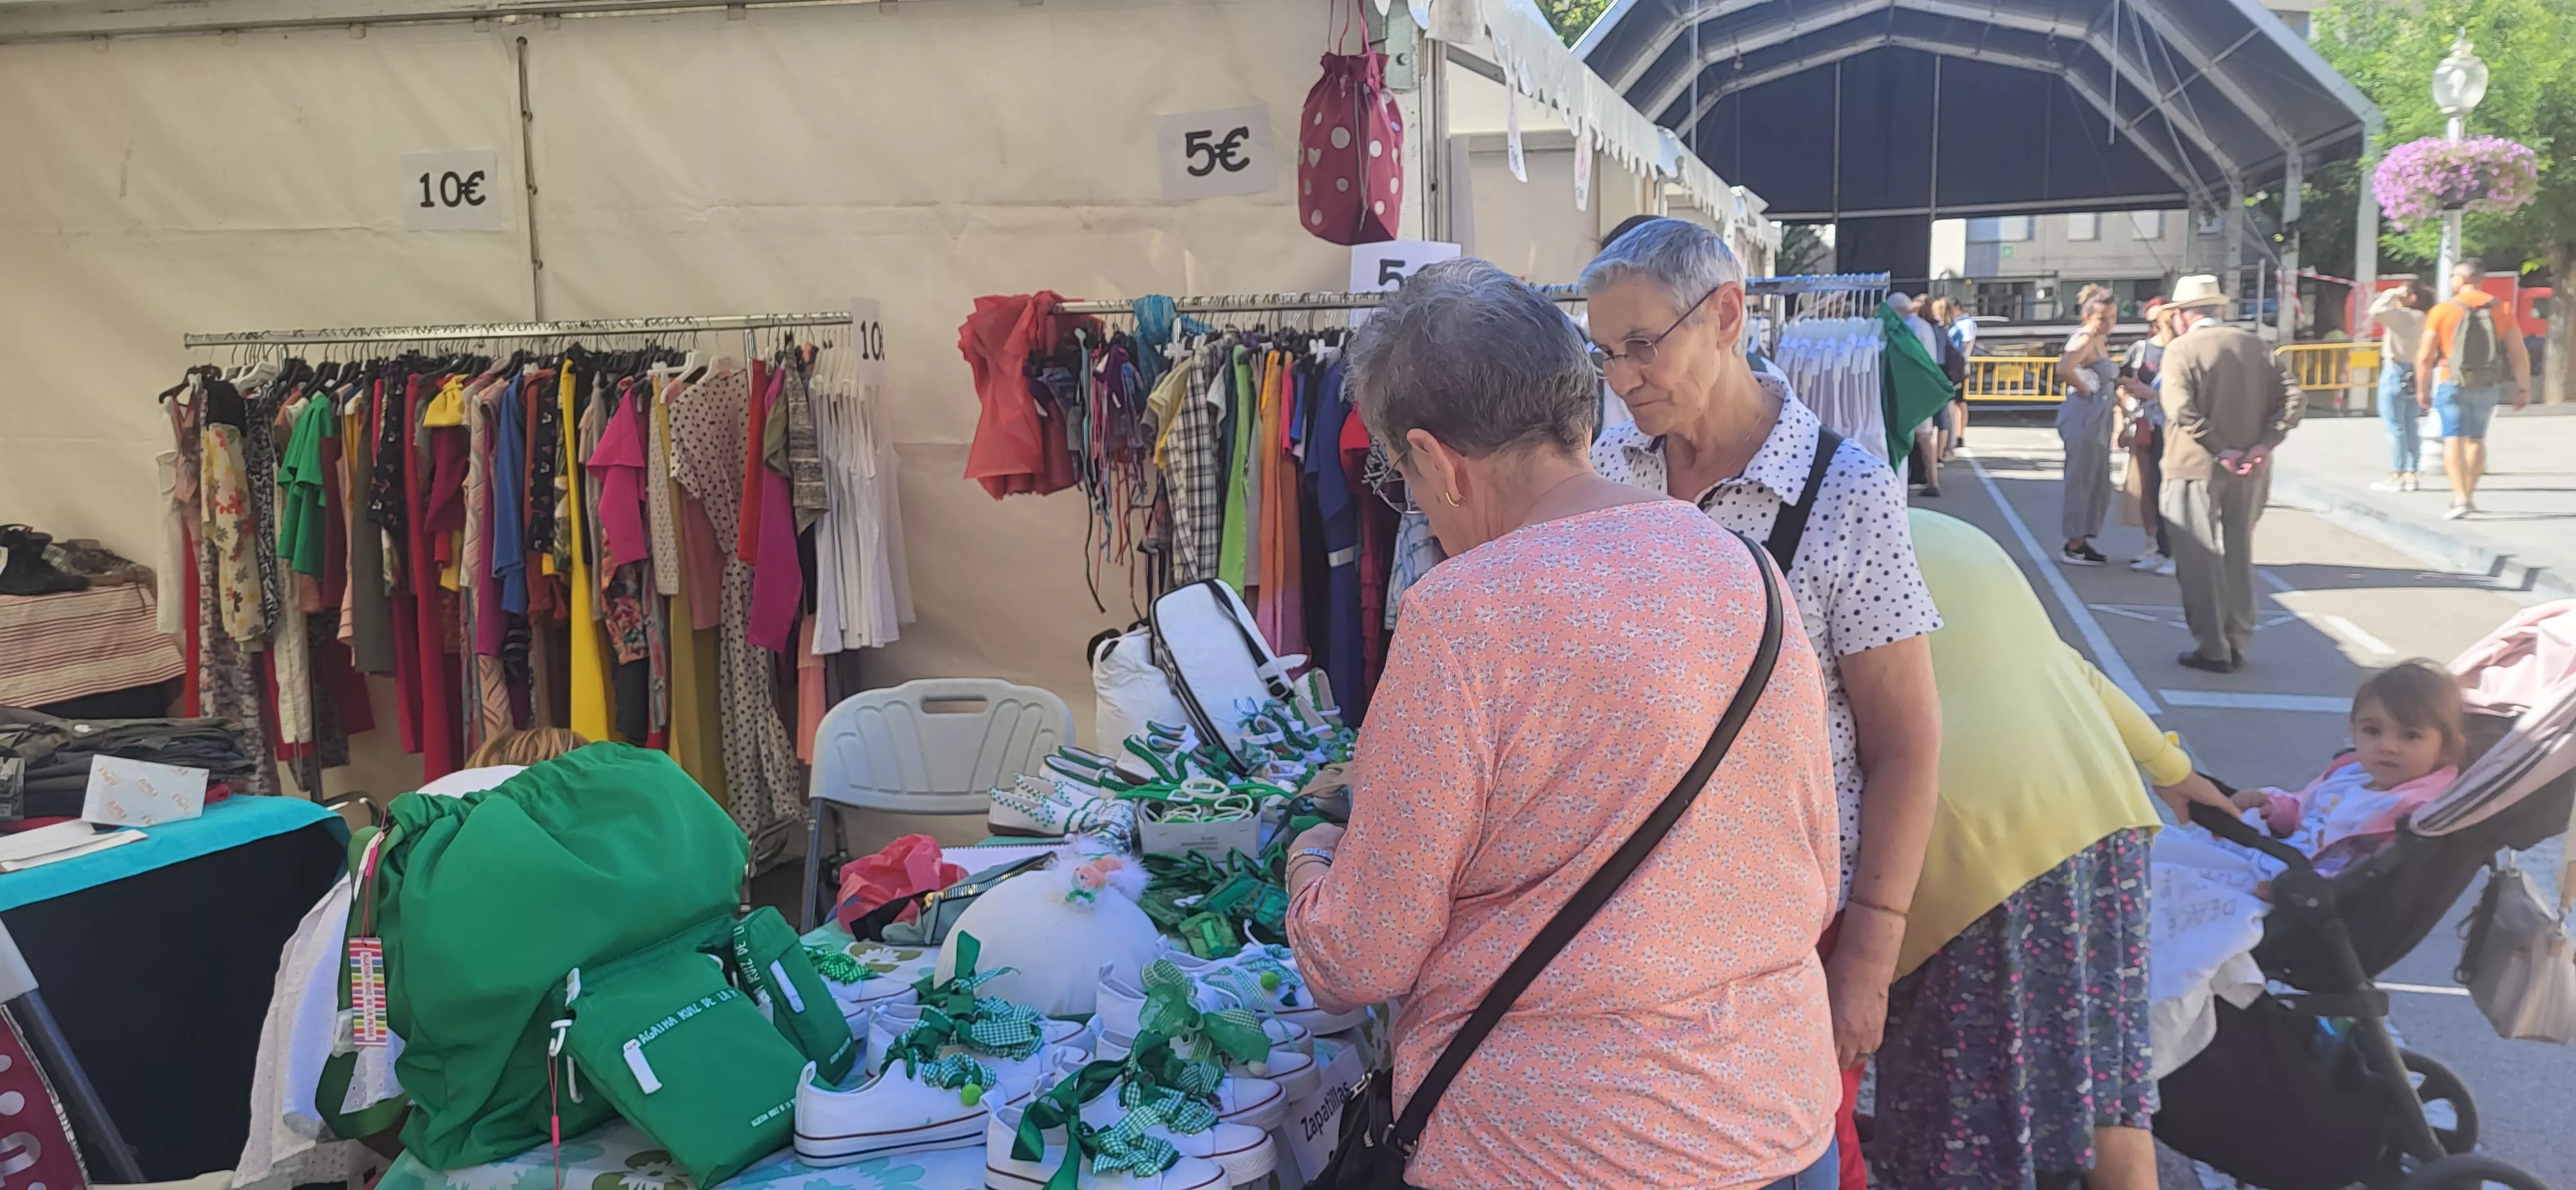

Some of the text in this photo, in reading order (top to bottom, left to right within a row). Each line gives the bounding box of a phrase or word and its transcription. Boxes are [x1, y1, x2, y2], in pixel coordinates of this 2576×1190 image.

[1185, 126, 1251, 177] 5€
[419, 170, 487, 208] 10€
[1378, 258, 1430, 291] 5
[735, 940, 749, 956] DE
[366, 1007, 374, 1017] LA
[1300, 1081, 1351, 1142] Zapatillas
